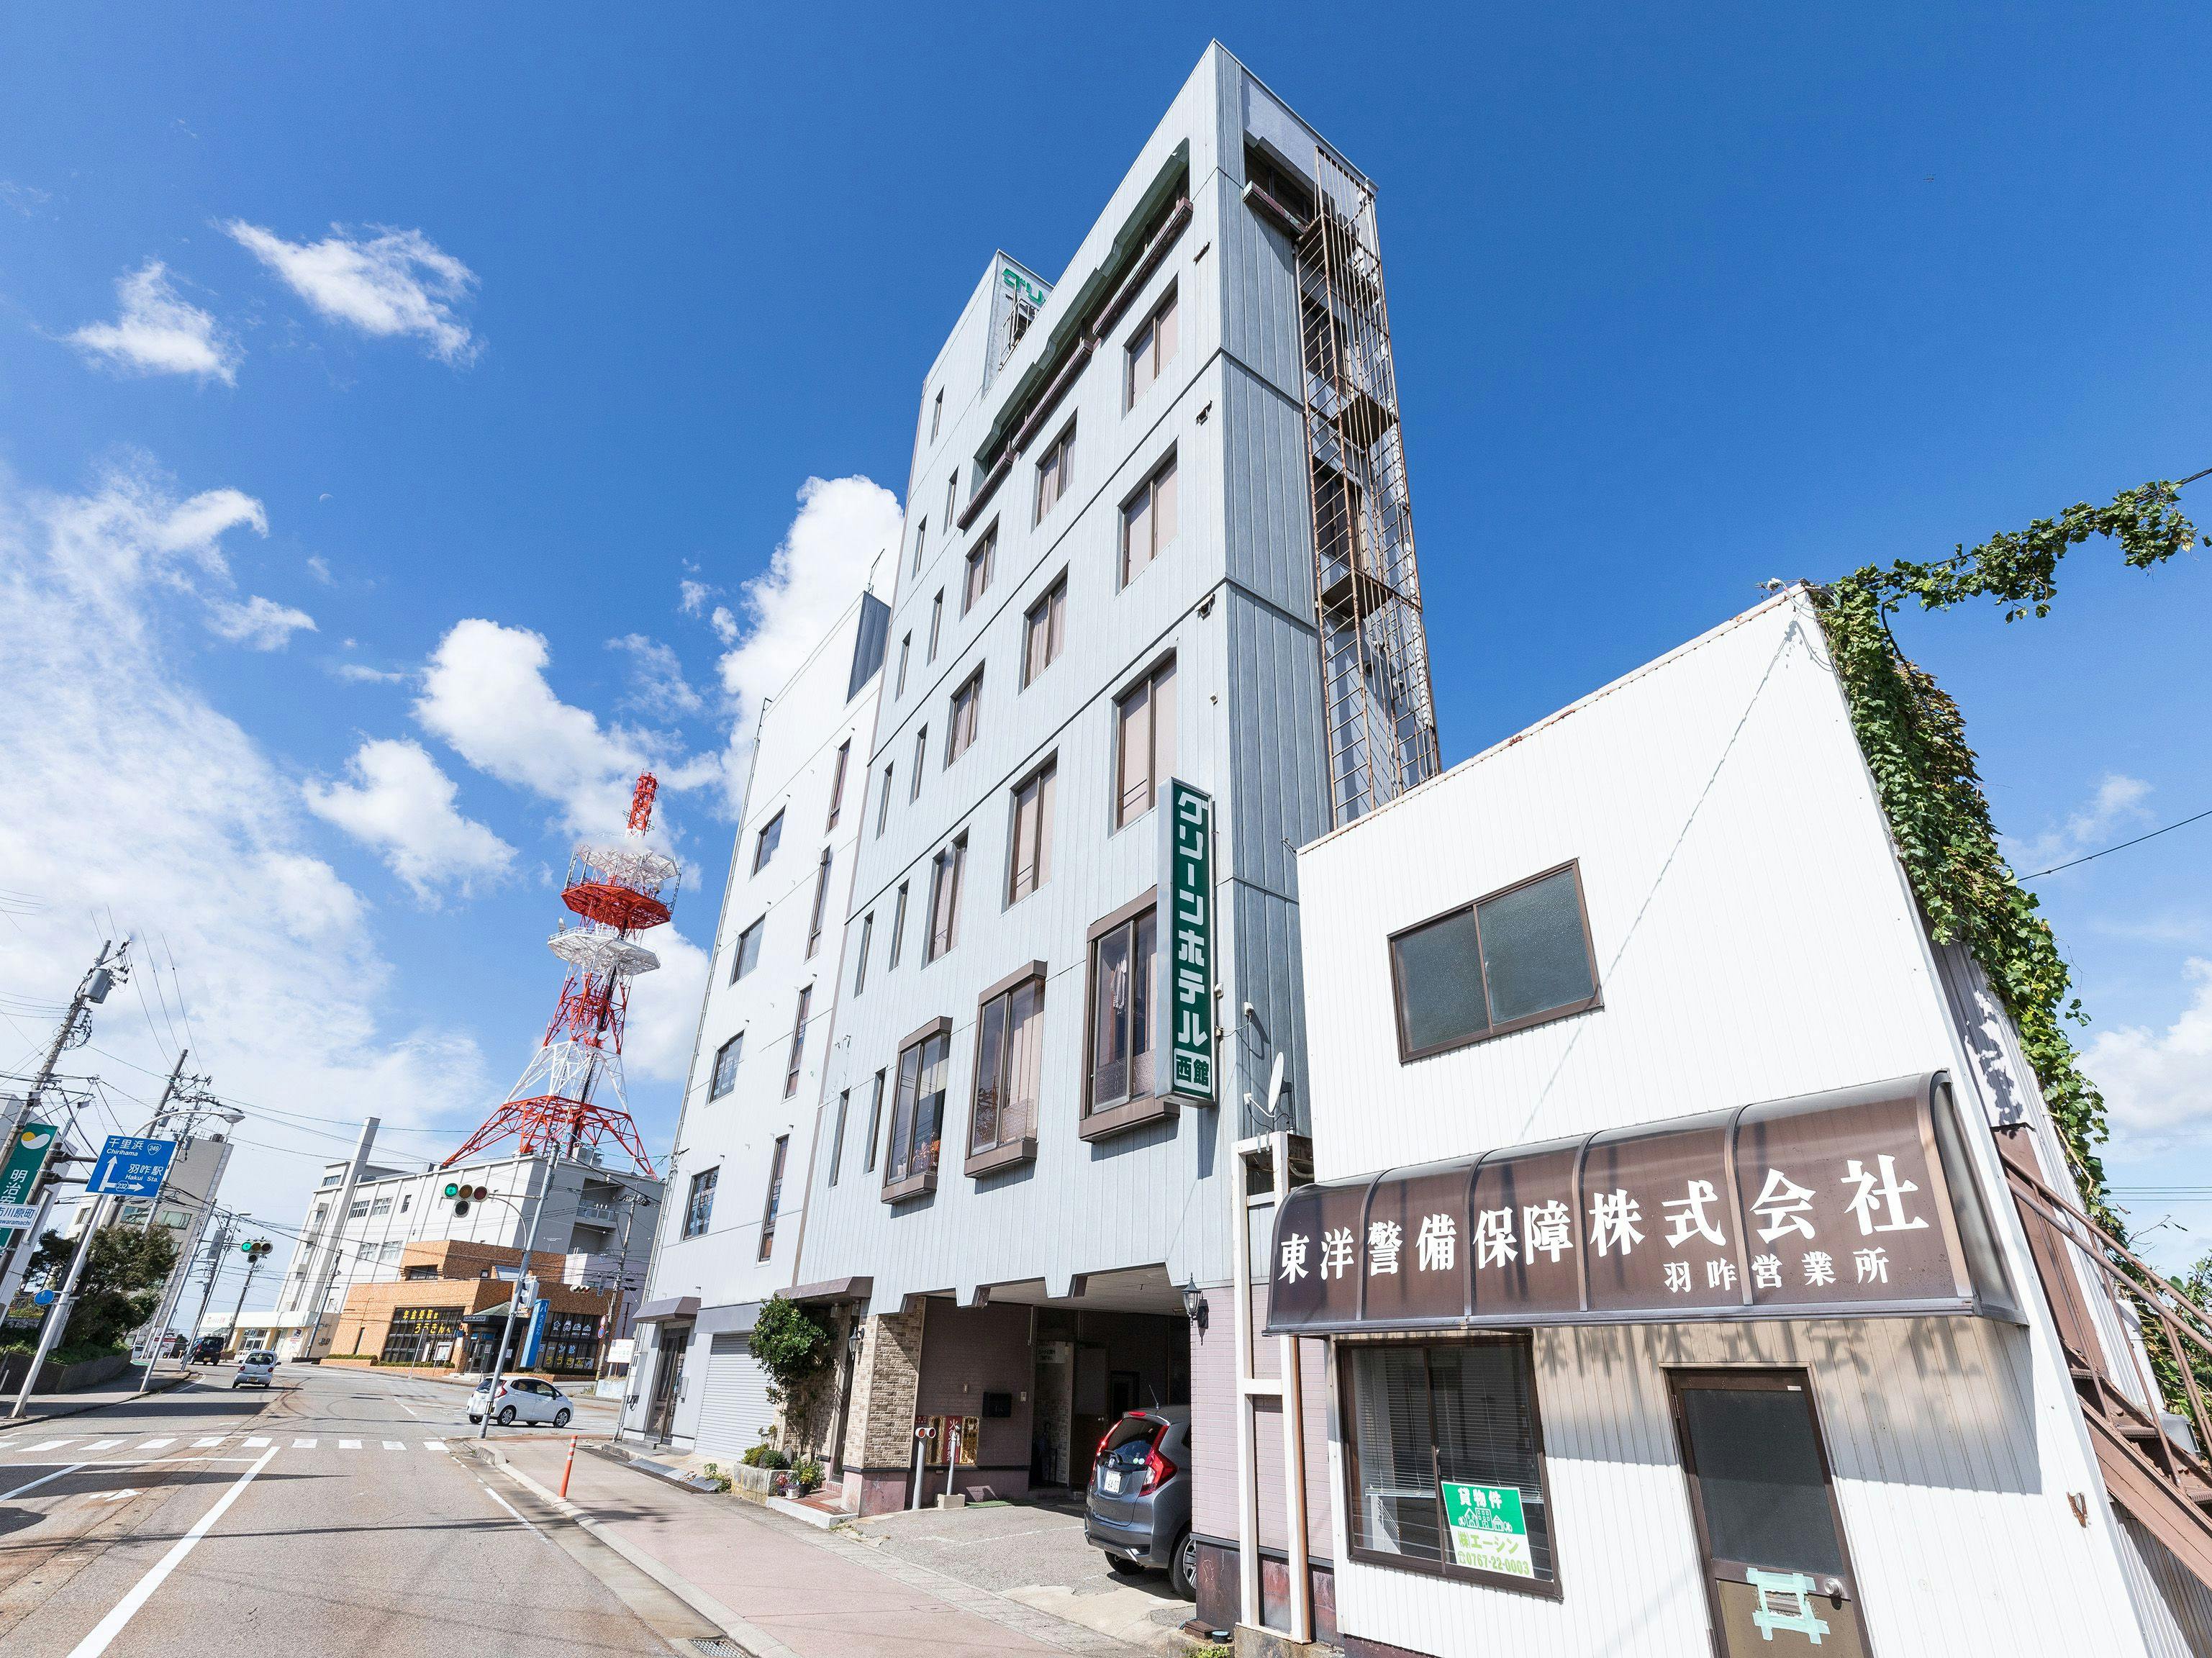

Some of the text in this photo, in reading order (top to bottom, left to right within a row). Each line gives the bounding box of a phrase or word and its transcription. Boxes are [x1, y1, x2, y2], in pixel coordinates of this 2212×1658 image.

[1002, 268, 1046, 305] グリ
[1178, 792, 1208, 1048] グリーンホテル
[1175, 1054, 1210, 1088] 西館
[106, 1149, 138, 1157] Chirihama
[109, 1138, 145, 1151] 千里浜
[127, 1164, 164, 1177] 羽咋駅
[1277, 1154, 1929, 1285] 東洋警備保障株式会社
[1663, 1248, 1890, 1295] 羽咋営業所
[1458, 1487, 1503, 1510] 貸物件
[1466, 1553, 1531, 1576] 0767-22-0003
